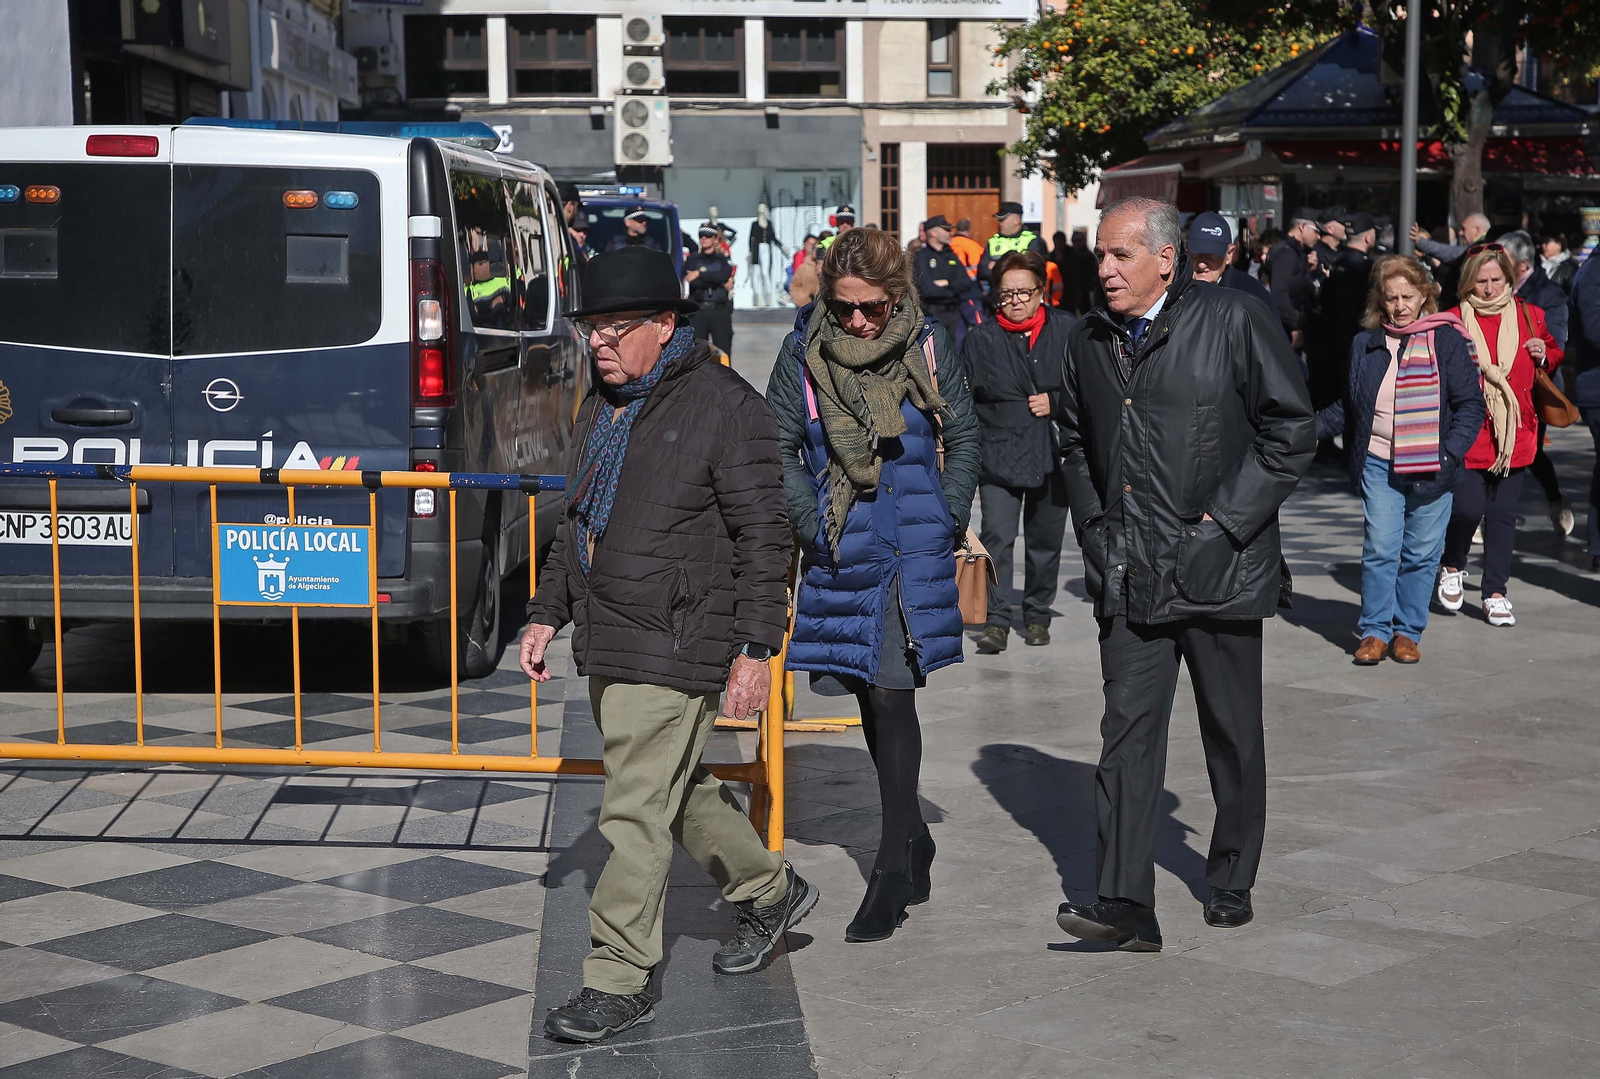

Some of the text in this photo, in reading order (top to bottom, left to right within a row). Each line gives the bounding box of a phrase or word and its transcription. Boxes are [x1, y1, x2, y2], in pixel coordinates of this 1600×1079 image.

[226, 528, 362, 552] POLICÍA LOCAL
[288, 575, 340, 585] Ayuntamiento
[298, 582, 331, 591] Algeciras
